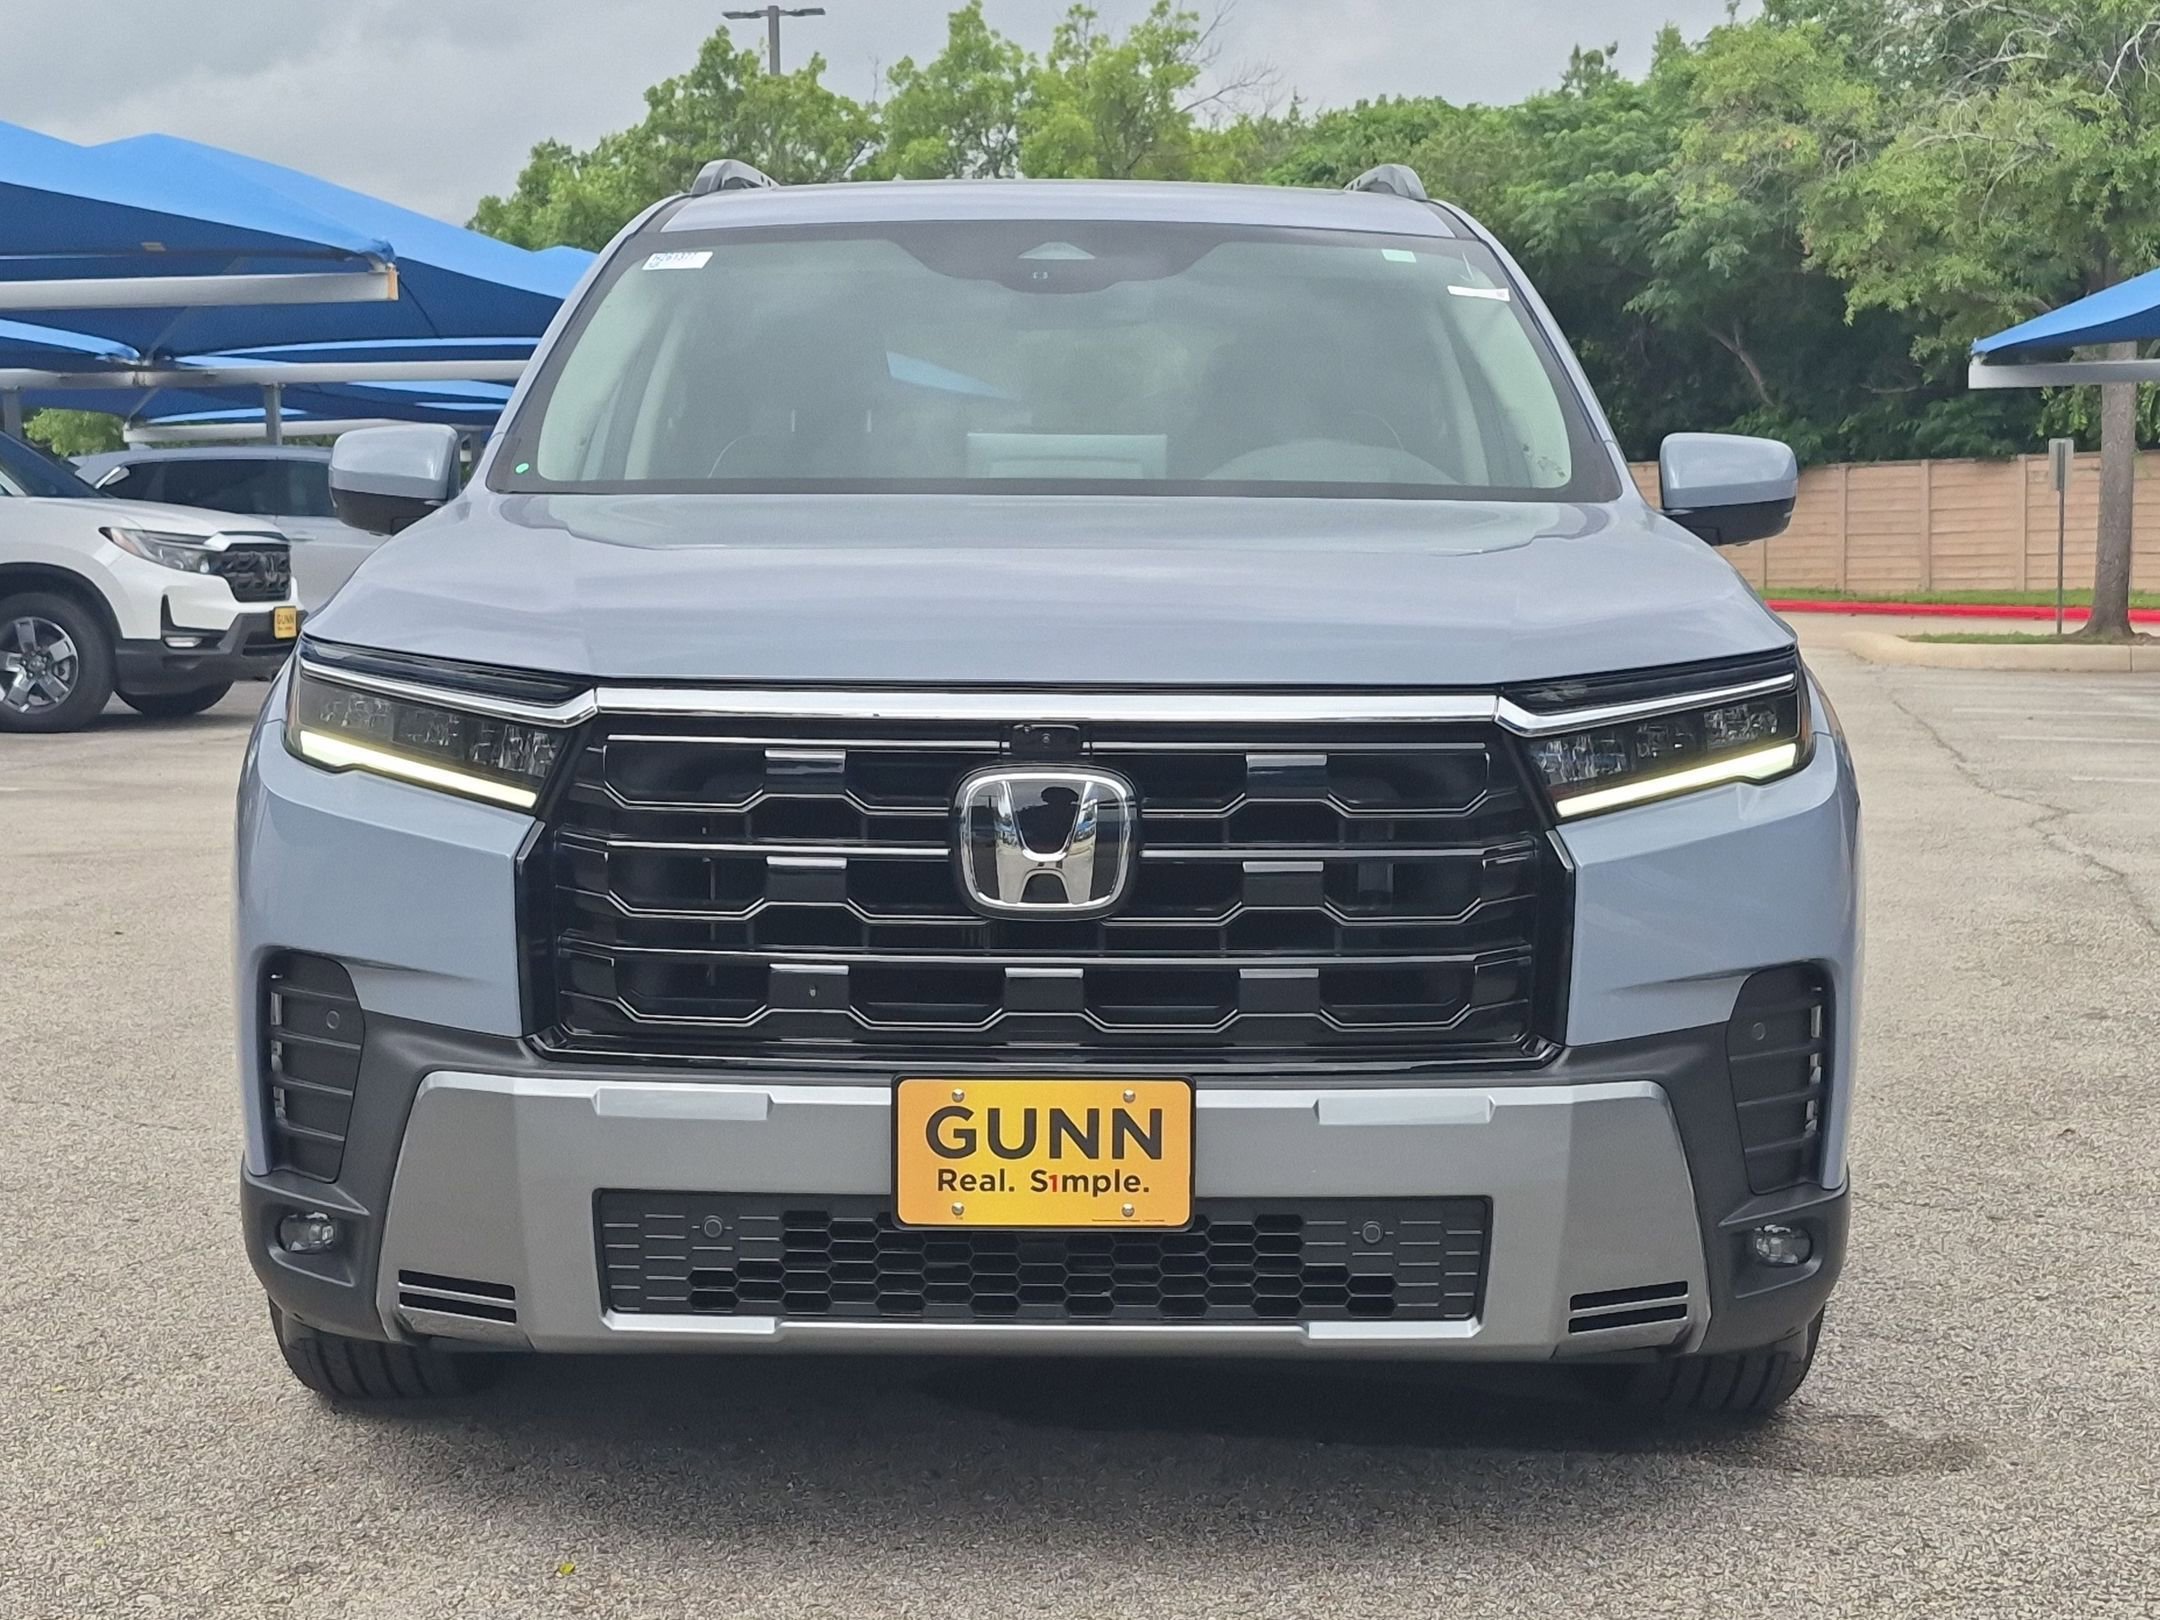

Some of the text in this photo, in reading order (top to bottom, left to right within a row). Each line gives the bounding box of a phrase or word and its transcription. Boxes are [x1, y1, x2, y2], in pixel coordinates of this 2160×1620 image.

[925, 1105, 1163, 1160] GUNN
[937, 1168, 1150, 1197] Real. S1mple.
